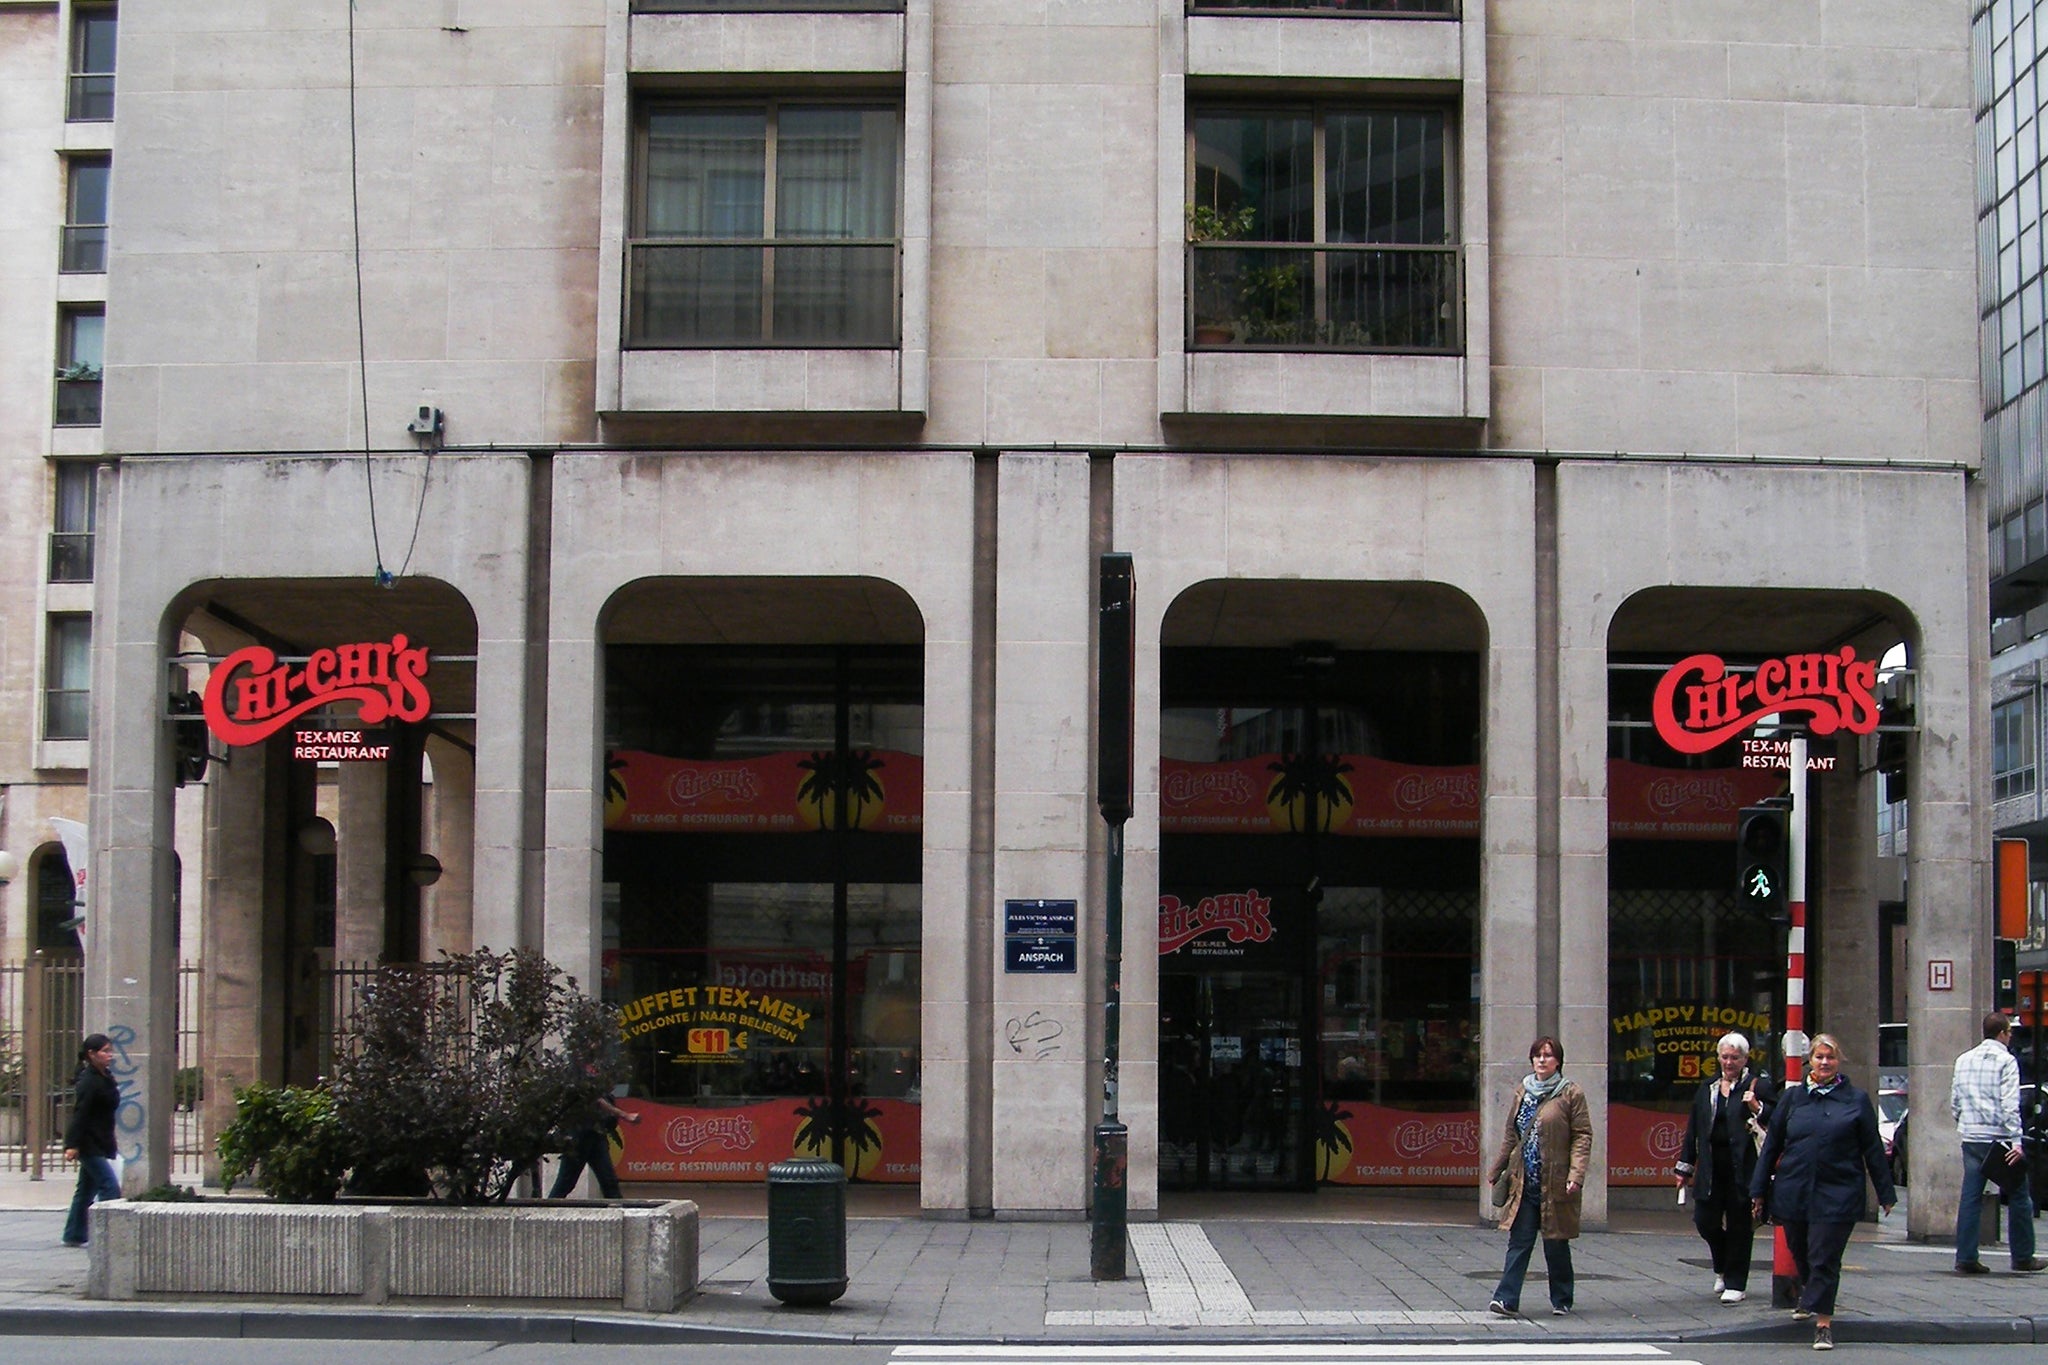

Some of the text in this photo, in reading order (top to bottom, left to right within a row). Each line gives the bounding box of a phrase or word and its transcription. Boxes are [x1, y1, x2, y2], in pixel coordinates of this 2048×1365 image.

[203, 633, 431, 746] CHI-CHI'S
[1653, 645, 1880, 754] CHI-CHI'S
[296, 731, 361, 744] TEX-MEX
[295, 746, 389, 759] RESTAURANT
[1742, 740, 1792, 753] TEX-M
[1742, 755, 1836, 769] RESTAUANT
[631, 814, 677, 824] TEX-MEX
[682, 814, 755, 824] RESTAURANT
[1357, 819, 1402, 828] TEX-MEX
[1018, 953, 1063, 962] ANSPACH
[1935, 966, 1947, 984] H
[705, 985, 811, 1030] TEX-MEX
[1612, 1005, 1771, 1034] HAPPY HOUR
[631, 1011, 690, 1037] VOLONTE
[700, 1011, 736, 1023] NAAR
[739, 1015, 798, 1043] BELIEVEN
[1653, 1026, 1708, 1038] BETWEEN
[1624, 1046, 1655, 1062] ALL
[1680, 1055, 1699, 1076] 5
[664, 1114, 755, 1155] CHI-CHI'S
[628, 1162, 674, 1172] TEX-MEX
[679, 1162, 752, 1172] RESTAURANT
[755, 1162, 765, 1172] &
[1356, 1165, 1480, 1176] TEX-MEX RESTAURANT
[1610, 1166, 1657, 1176] TEX-MEX
